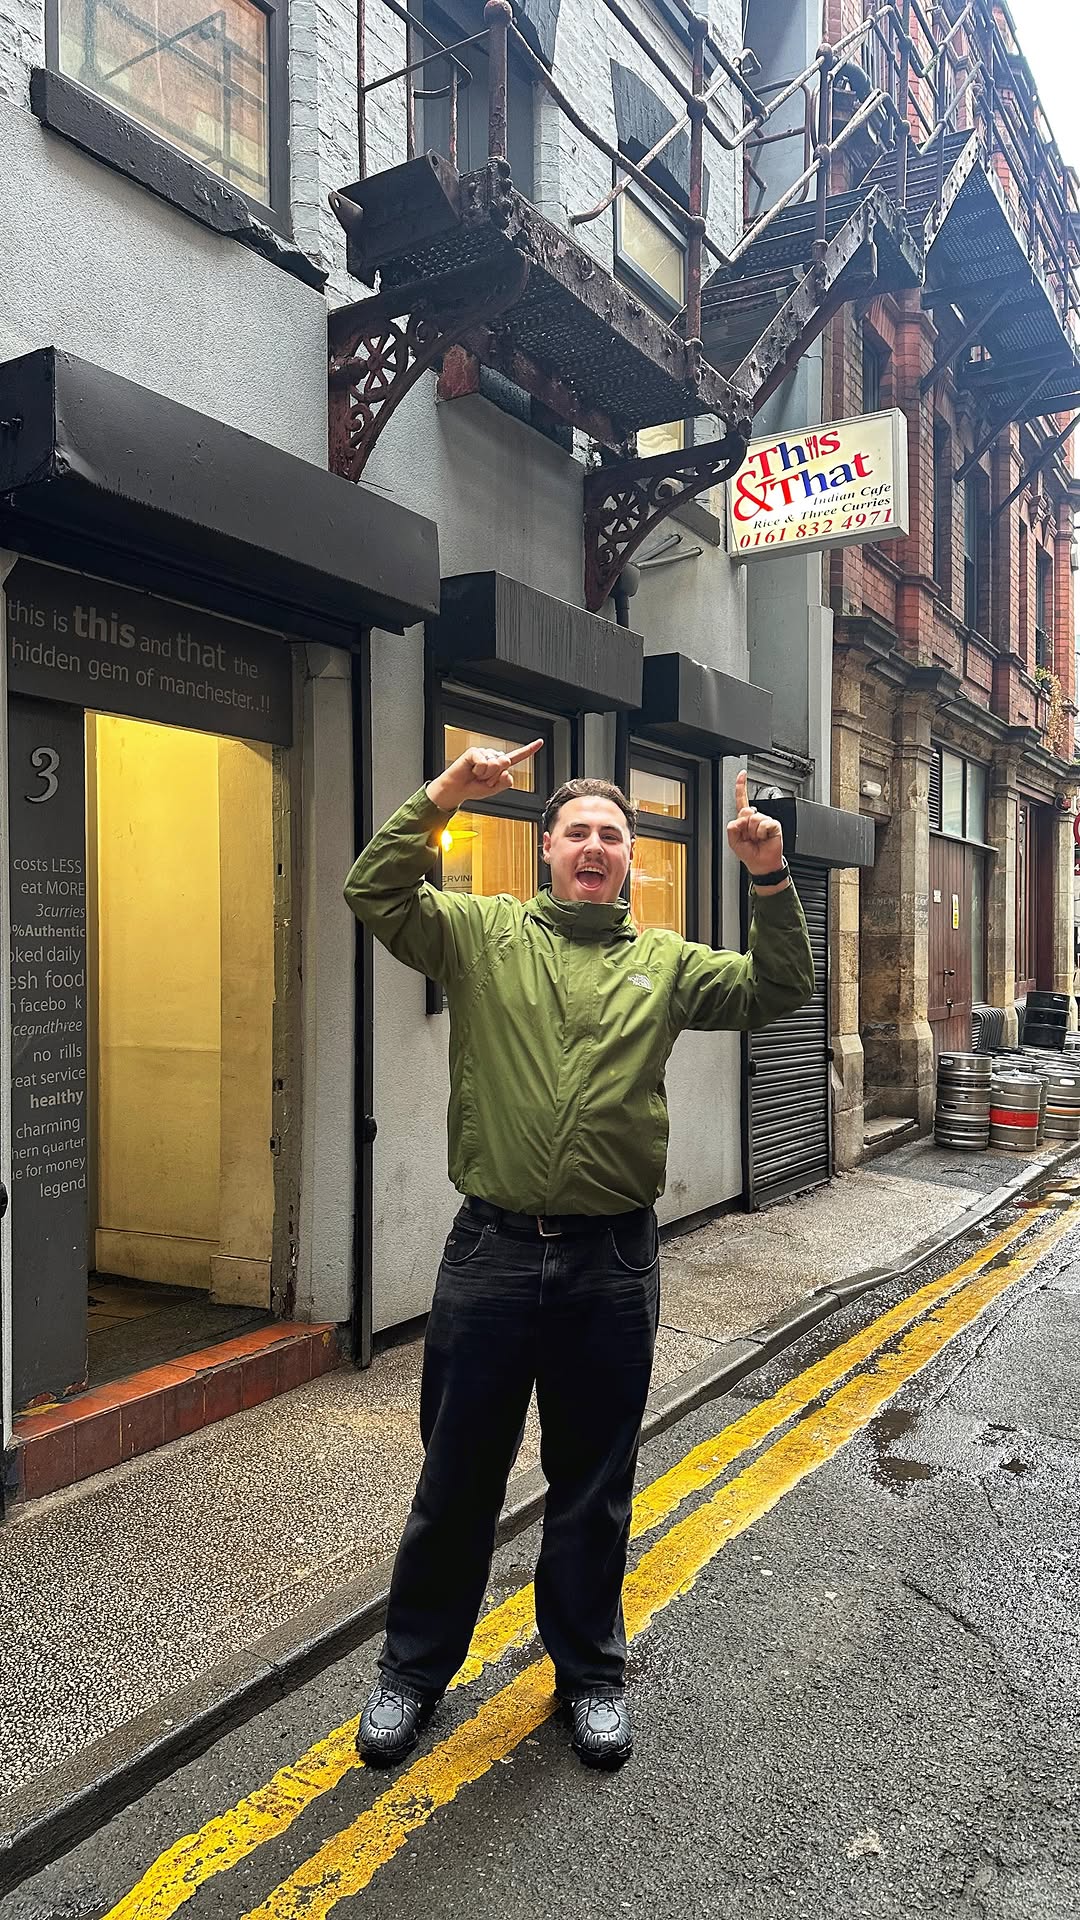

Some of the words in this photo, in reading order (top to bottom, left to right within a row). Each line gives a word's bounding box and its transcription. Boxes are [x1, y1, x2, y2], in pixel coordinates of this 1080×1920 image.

[733, 470, 777, 522] &
[770, 452, 874, 506] That
[813, 491, 856, 506] Indian
[860, 483, 892, 498] Cafe
[753, 518, 780, 530] Rice
[784, 514, 794, 524] &
[801, 507, 838, 520] Three
[841, 497, 891, 513] Curries
[739, 527, 787, 549] 0161
[795, 519, 834, 539] 832
[840, 508, 892, 531] 4971
[7, 599, 46, 628] this
[53, 609, 69, 633] is
[72, 605, 137, 649] this
[140, 635, 172, 658] and
[176, 633, 227, 672] that
[234, 657, 259, 679] the
[11, 636, 81, 673] hidden
[88, 658, 130, 683] gem
[135, 667, 155, 688] of
[25, 746, 60, 804] 3
[13, 858, 49, 872] costs
[52, 857, 82, 875] LESS
[20, 881, 43, 895] eat
[46, 880, 85, 896] MORE
[35, 903, 86, 919] 3curries
[10, 924, 86, 938] %Authentic
[46, 944, 82, 966] daily
[44, 968, 85, 989] food
[33, 1050, 52, 1063] no
[40, 1066, 86, 1085] service
[30, 1088, 84, 1109] healthy
[15, 1117, 81, 1139] charming
[42, 1137, 86, 1157] quarter
[25, 1163, 43, 1178] for
[45, 1156, 86, 1174] money
[40, 1173, 86, 1199] legend
